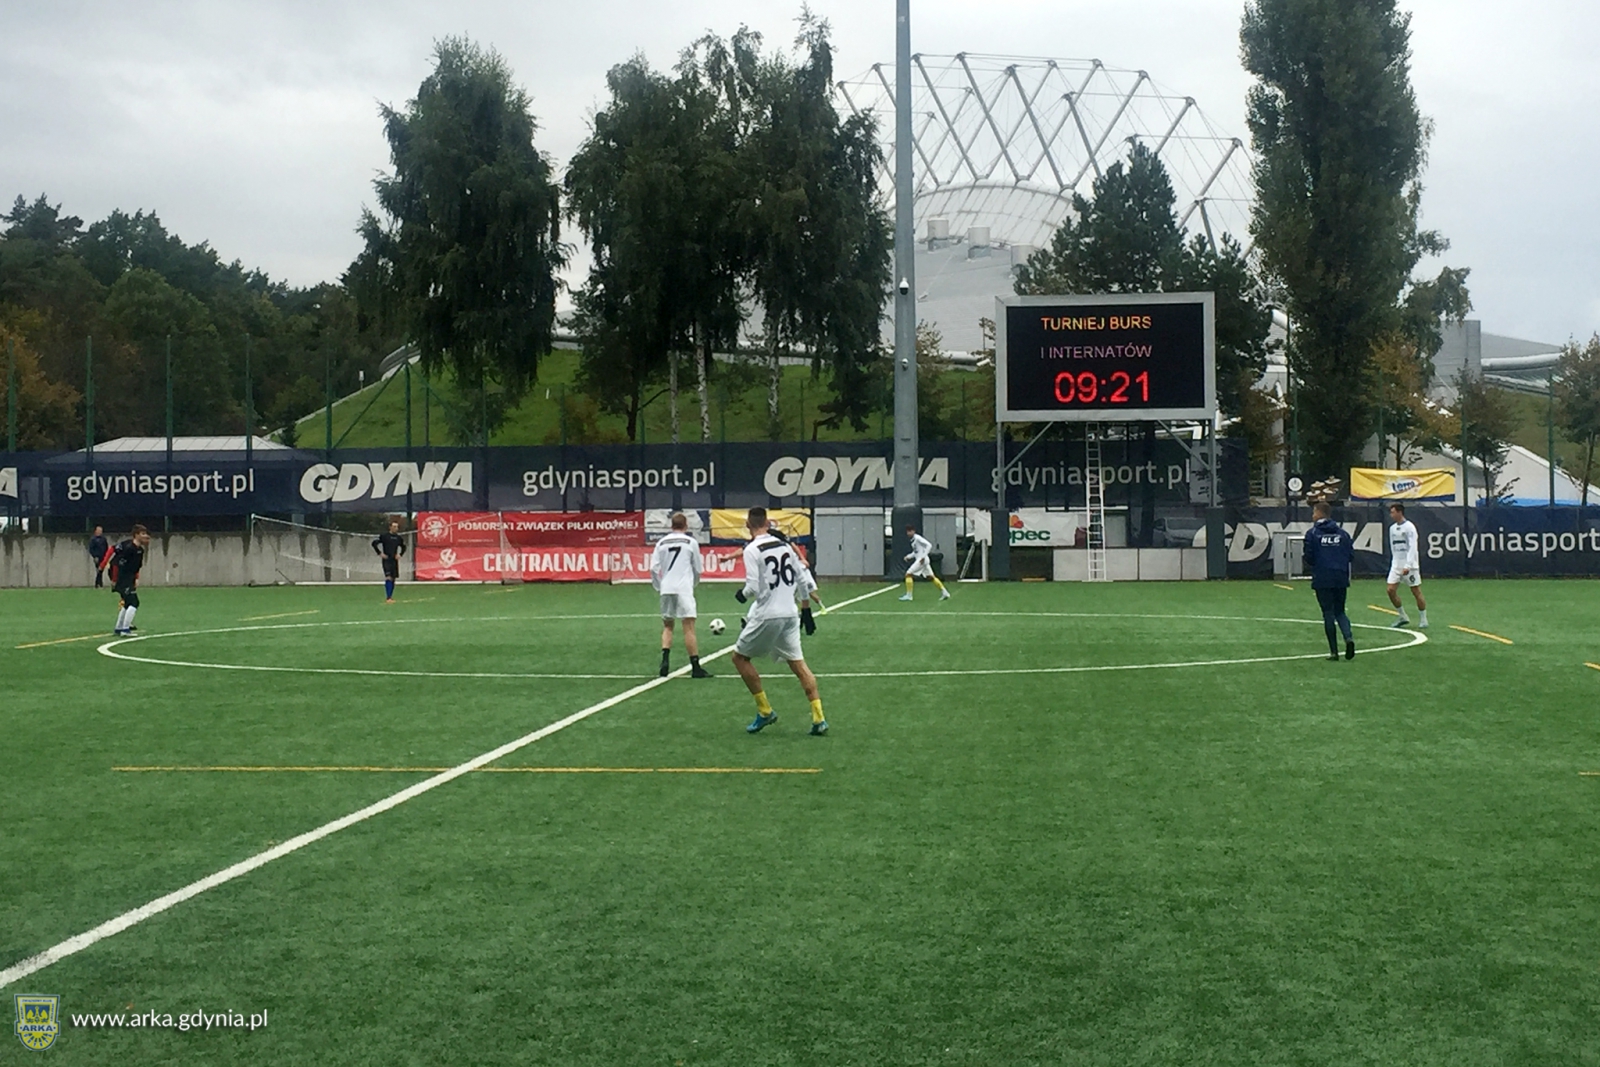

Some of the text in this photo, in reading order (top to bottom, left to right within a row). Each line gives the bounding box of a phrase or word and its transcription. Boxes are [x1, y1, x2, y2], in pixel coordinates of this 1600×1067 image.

[1041, 316, 1152, 330] TURNIEJ BURS
[1041, 343, 1152, 359] I INTERNATÓW
[1054, 371, 1149, 403] 09:21
[67, 468, 254, 499] gdyniasport.pl
[300, 462, 473, 503] GDYNIA
[523, 462, 715, 496] gdyniasport.pl
[764, 457, 949, 497] GDYNA
[991, 460, 1189, 492] gdyniasport.pl
[457, 519, 638, 532] POMORSKI ZWIĄZEK PIŁKI NOŻNEJ
[1008, 530, 1051, 543] pec
[483, 553, 589, 572] CENTRALNA
[593, 553, 633, 572] LIGA
[668, 546, 682, 571] 7
[764, 553, 795, 590] 36
